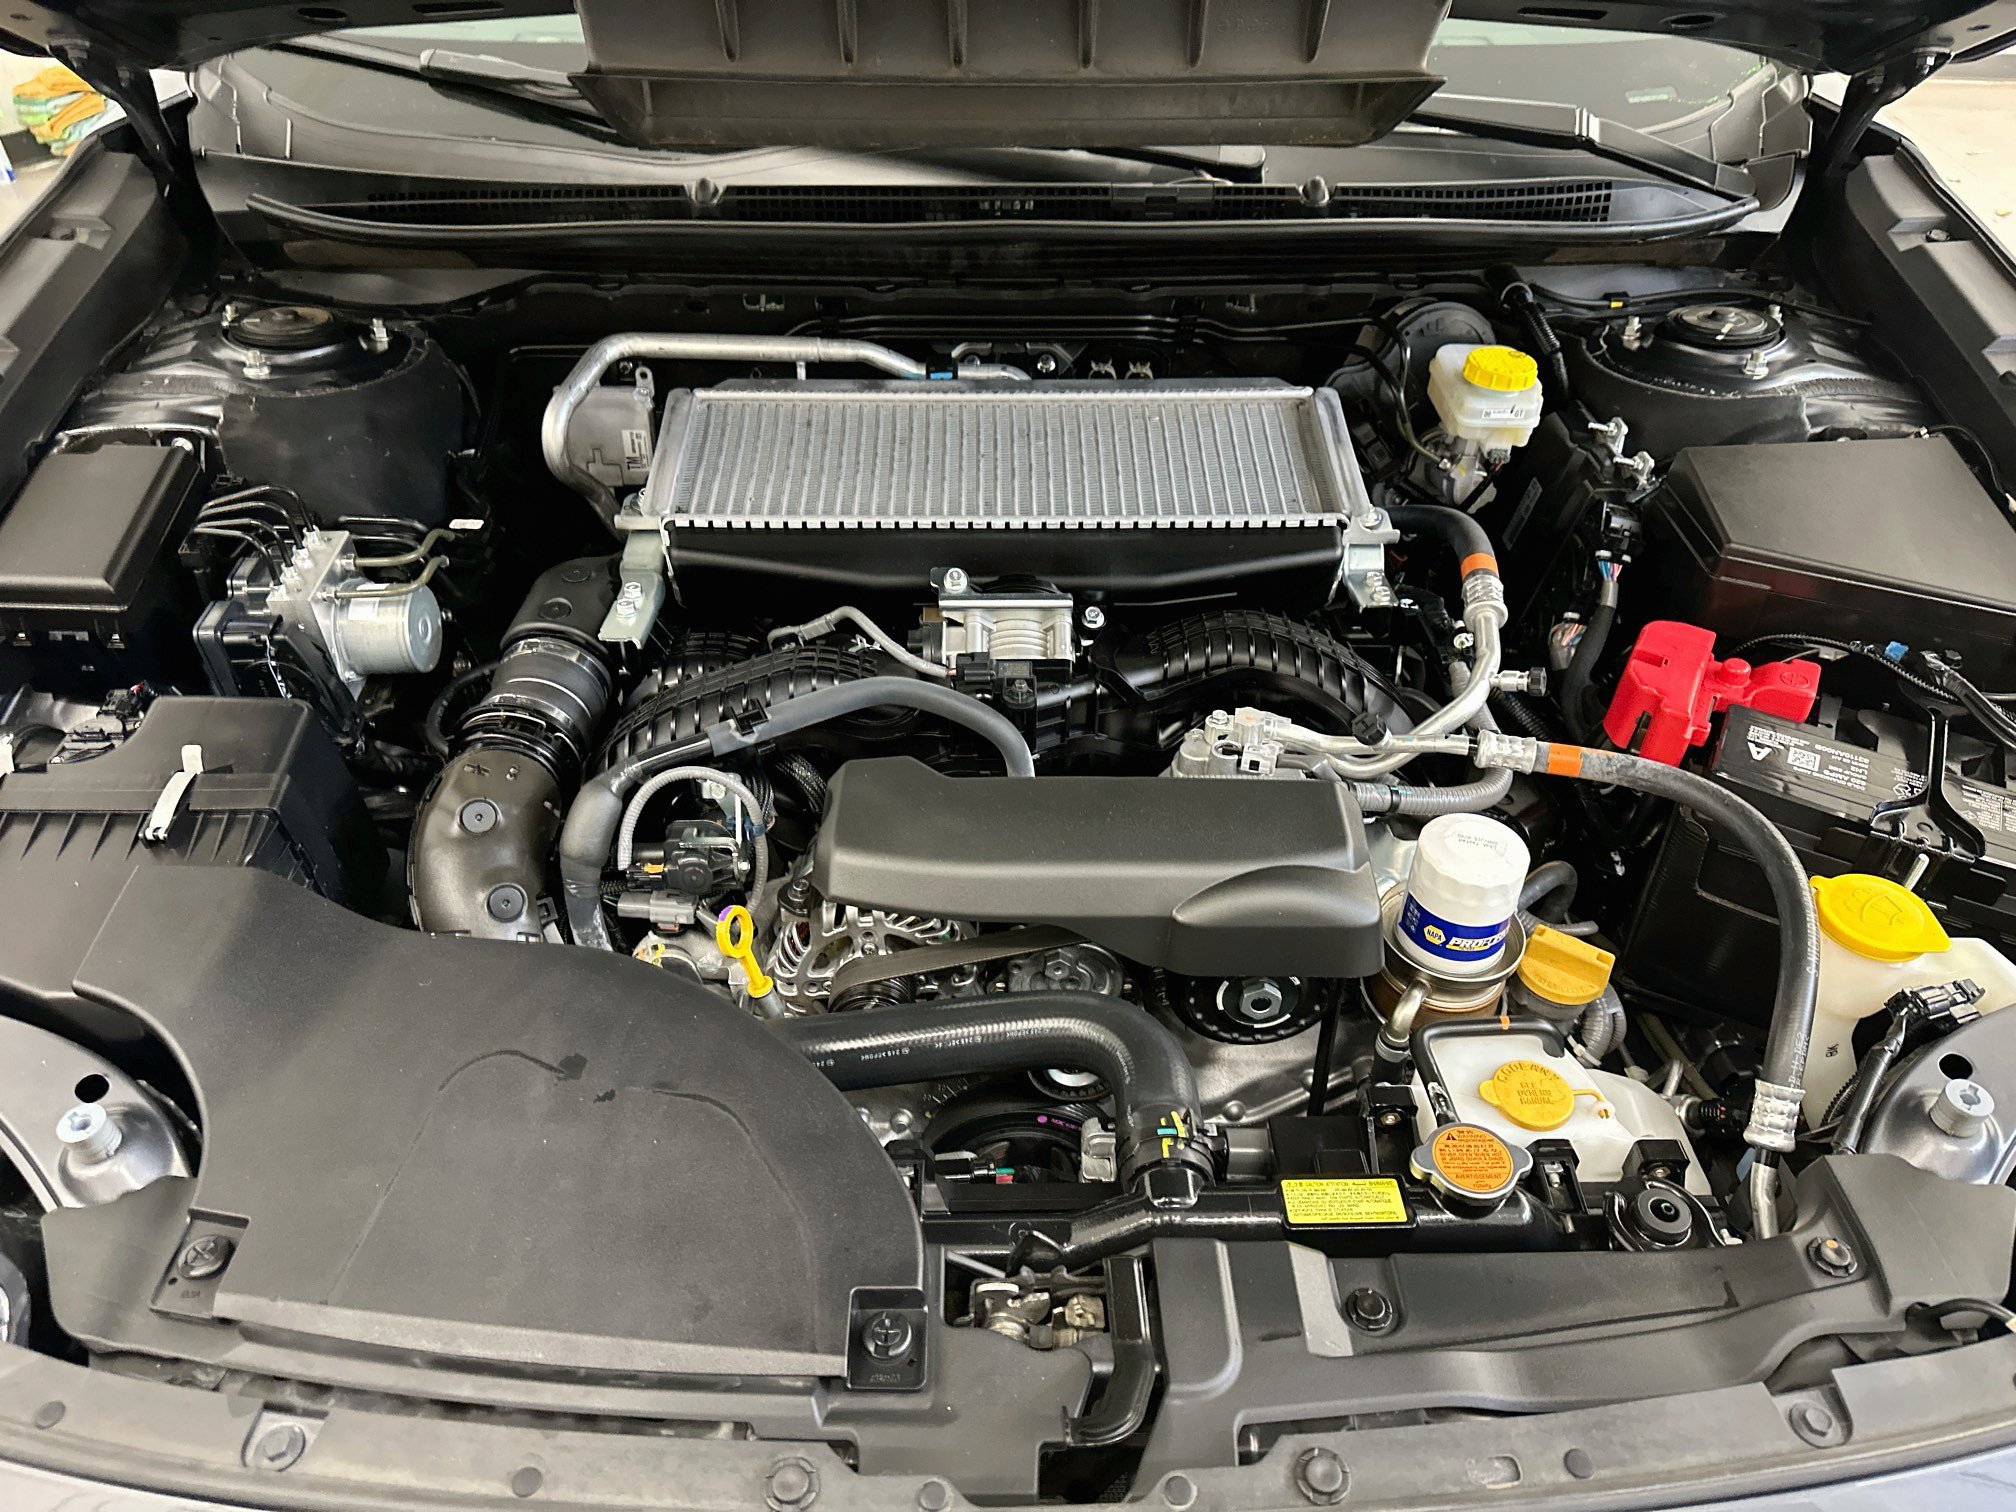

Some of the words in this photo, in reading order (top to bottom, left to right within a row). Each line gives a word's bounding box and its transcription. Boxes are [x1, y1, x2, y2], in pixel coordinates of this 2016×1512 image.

[626, 456, 641, 471] TM
[1792, 766, 1812, 775] AMPS
[1823, 769, 1850, 781] AMPS
[1812, 771, 1847, 785] CRANKING
[1846, 782, 1866, 791] COLD
[1426, 928, 1442, 942] NAPA
[1496, 1062, 1560, 1083] COOLANT
